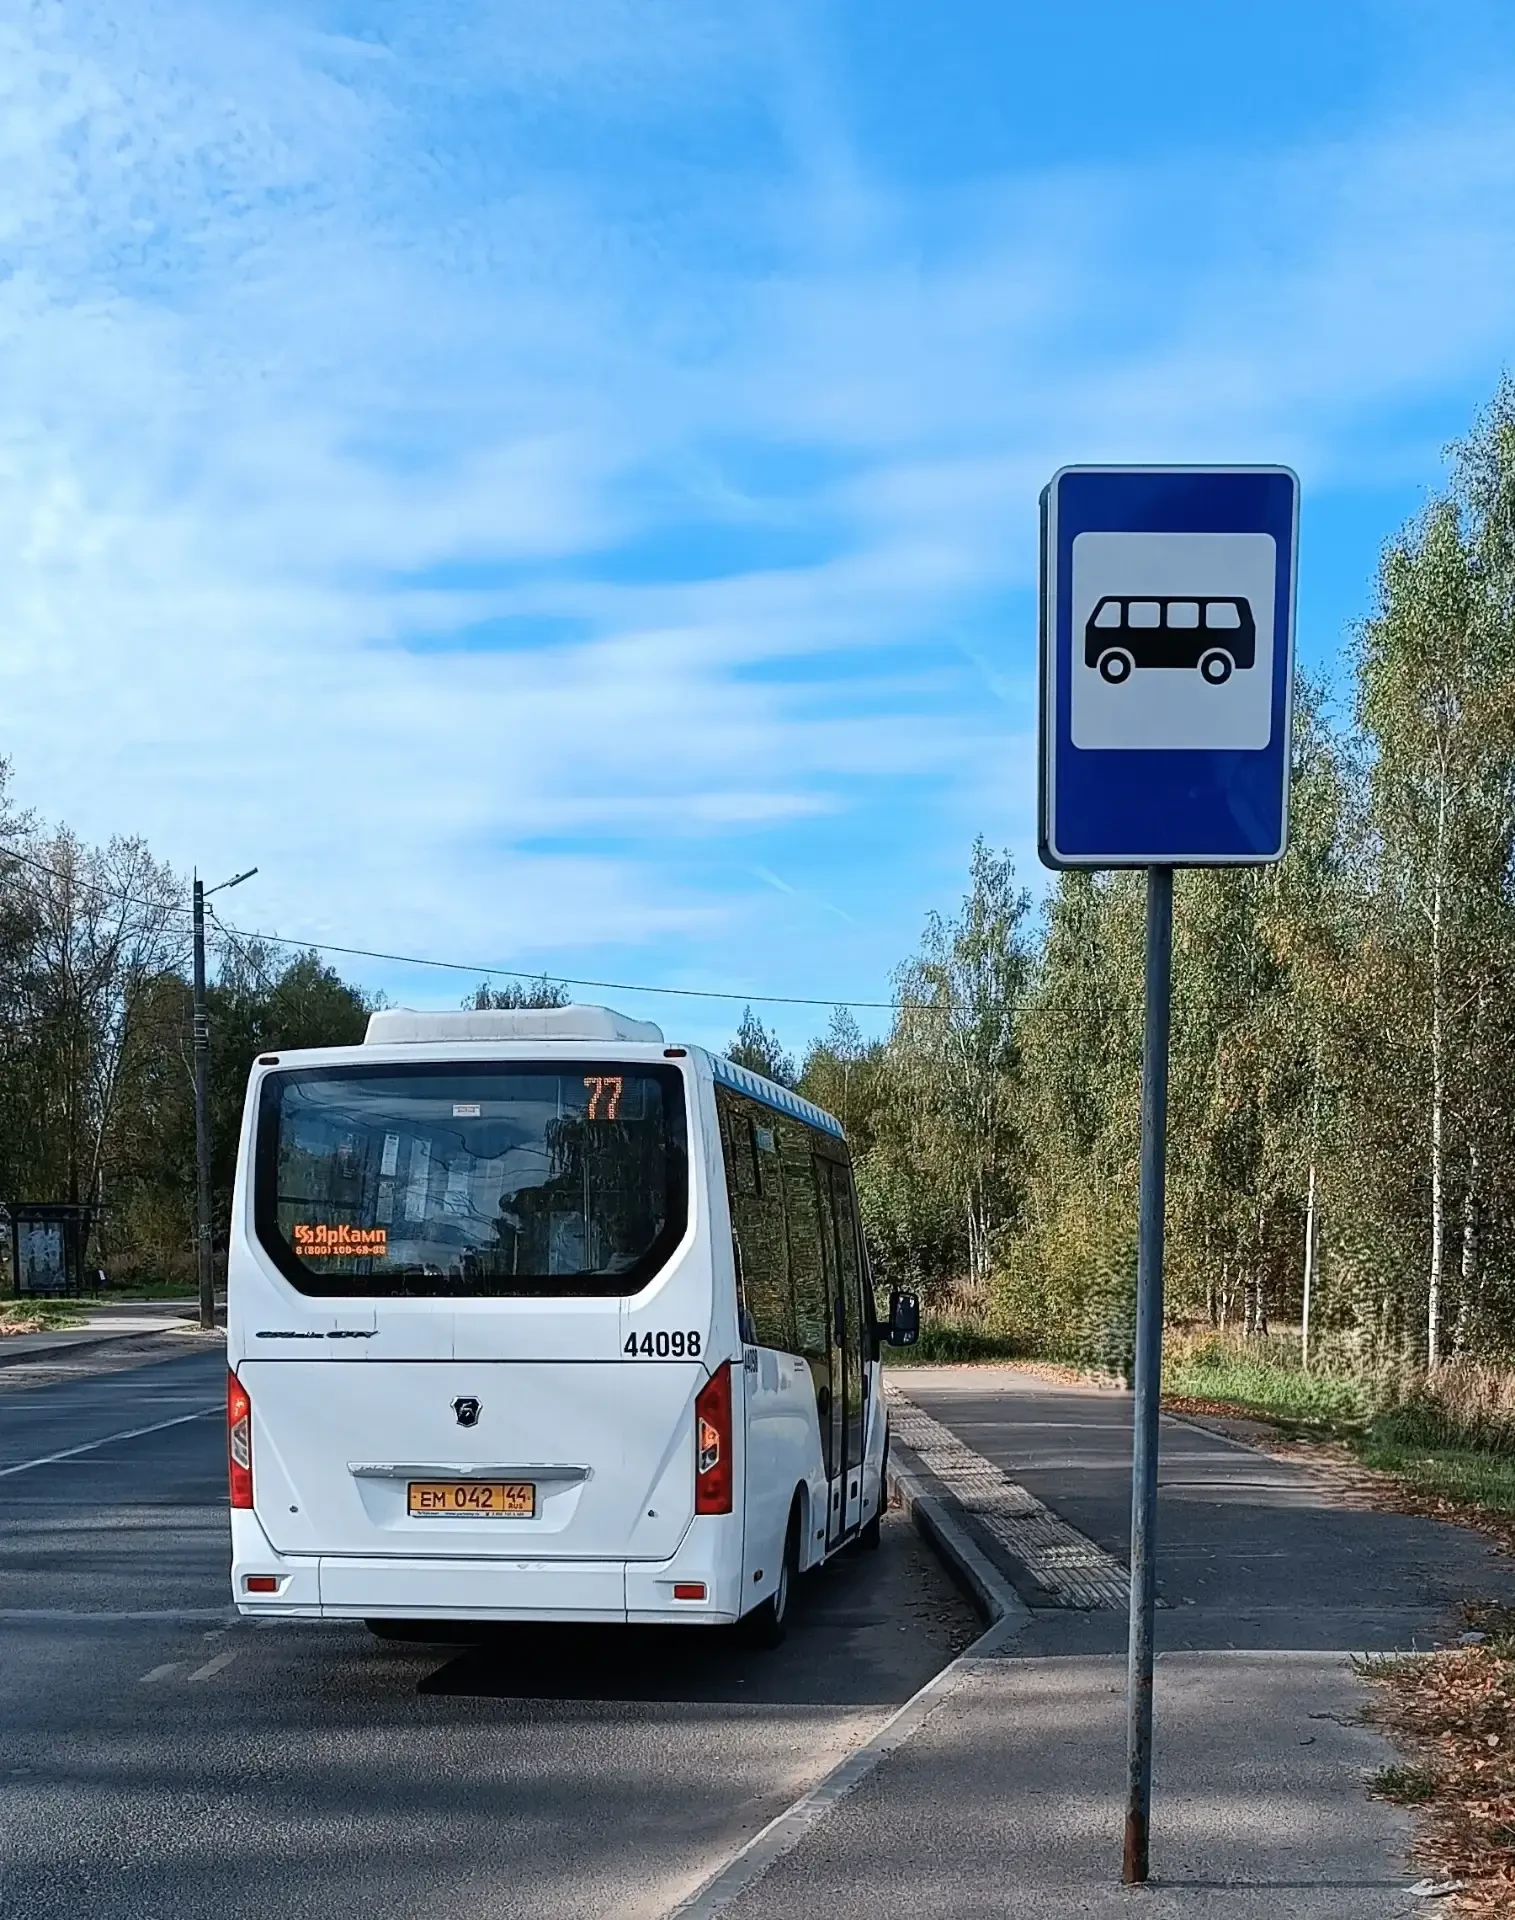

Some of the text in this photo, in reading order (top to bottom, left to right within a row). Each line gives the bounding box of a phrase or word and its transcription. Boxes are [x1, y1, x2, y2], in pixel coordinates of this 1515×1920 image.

[584, 1077, 622, 1119] 77
[316, 1225, 386, 1246] ЯрКамп
[296, 1246, 302, 1254] 8
[624, 1331, 700, 1357] 44098
[454, 1487, 493, 1508] 042
[505, 1486, 526, 1502] 44
